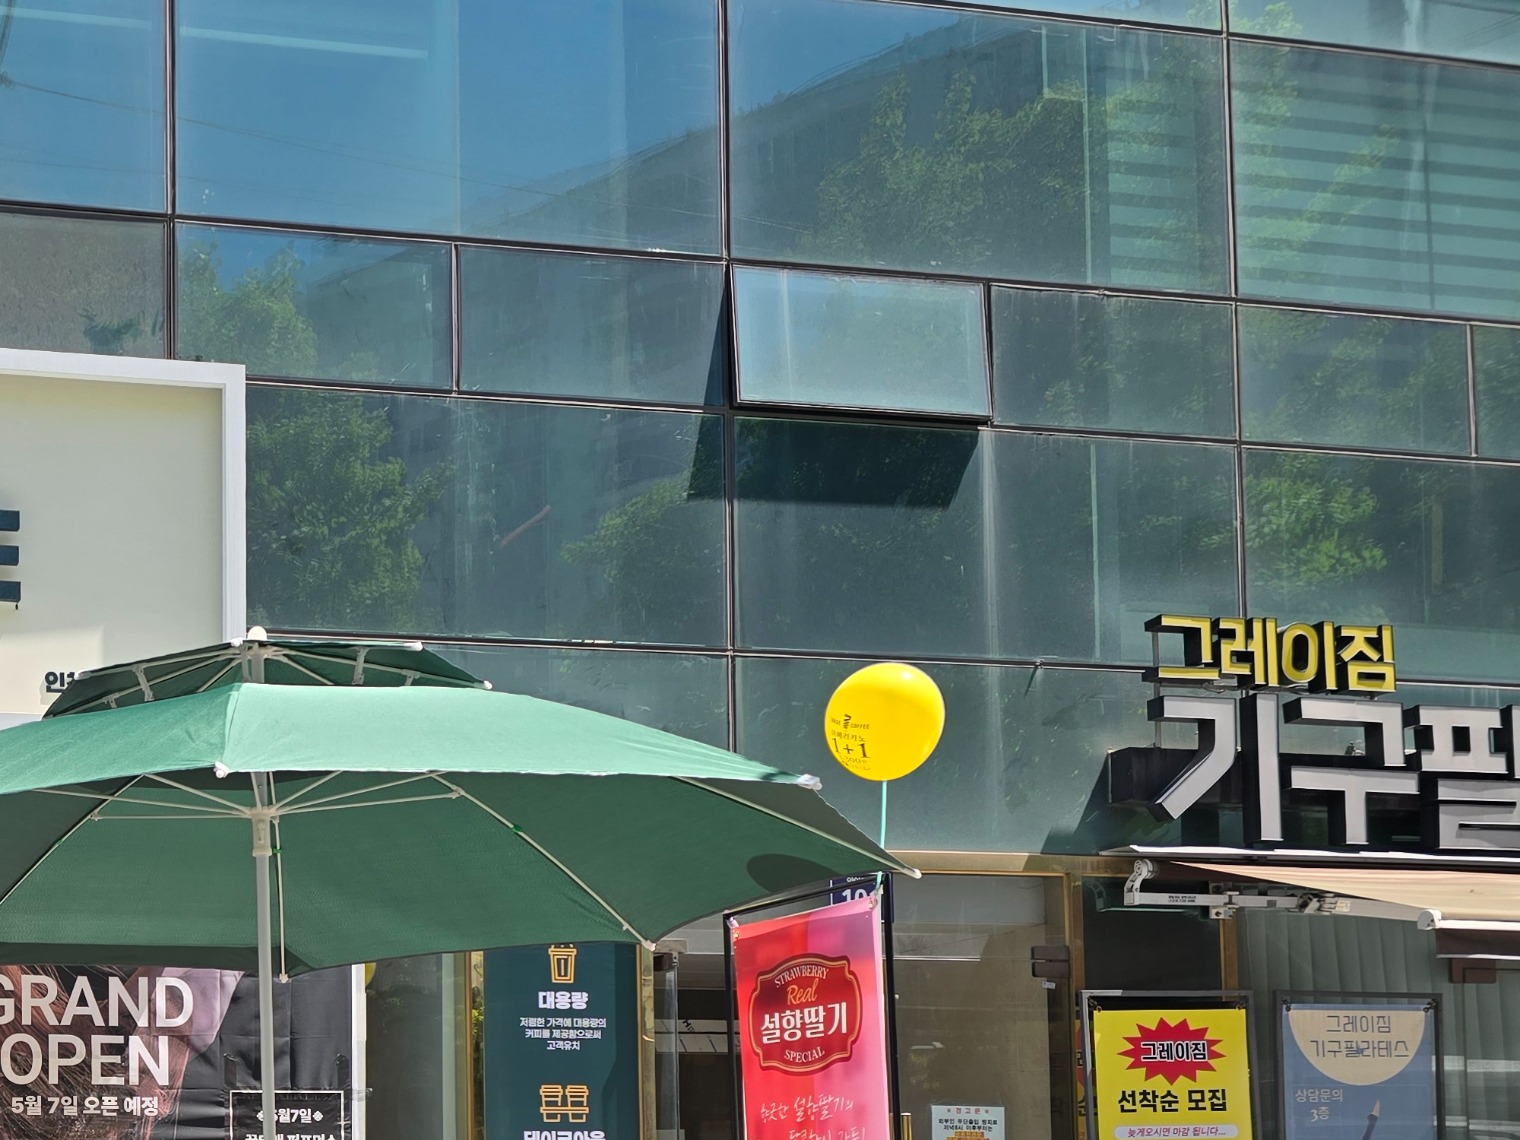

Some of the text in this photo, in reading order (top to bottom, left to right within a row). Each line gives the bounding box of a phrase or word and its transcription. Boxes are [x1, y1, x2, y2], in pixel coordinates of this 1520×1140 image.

[1142, 614, 1397, 693] 그레이짐
[774, 964, 830, 989] STRAWBERRY
[537, 991, 589, 1010] 대용량
[786, 978, 820, 1006] Real
[760, 1001, 848, 1045] 설향딸기
[1326, 1015, 1392, 1034] 그레이짐
[783, 1046, 826, 1063] SPECIAL
[1141, 1041, 1209, 1062] 그레이짐
[1309, 1040, 1410, 1059] 기구필라테스
[0, 1033, 170, 1088] OPEN
[1117, 1088, 1228, 1114] 선착순 모집
[1295, 1088, 1344, 1103] 상담문의
[11, 1096, 159, 1117] 5월 7일 오픈 예정
[1309, 1106, 1330, 1122] 3층
